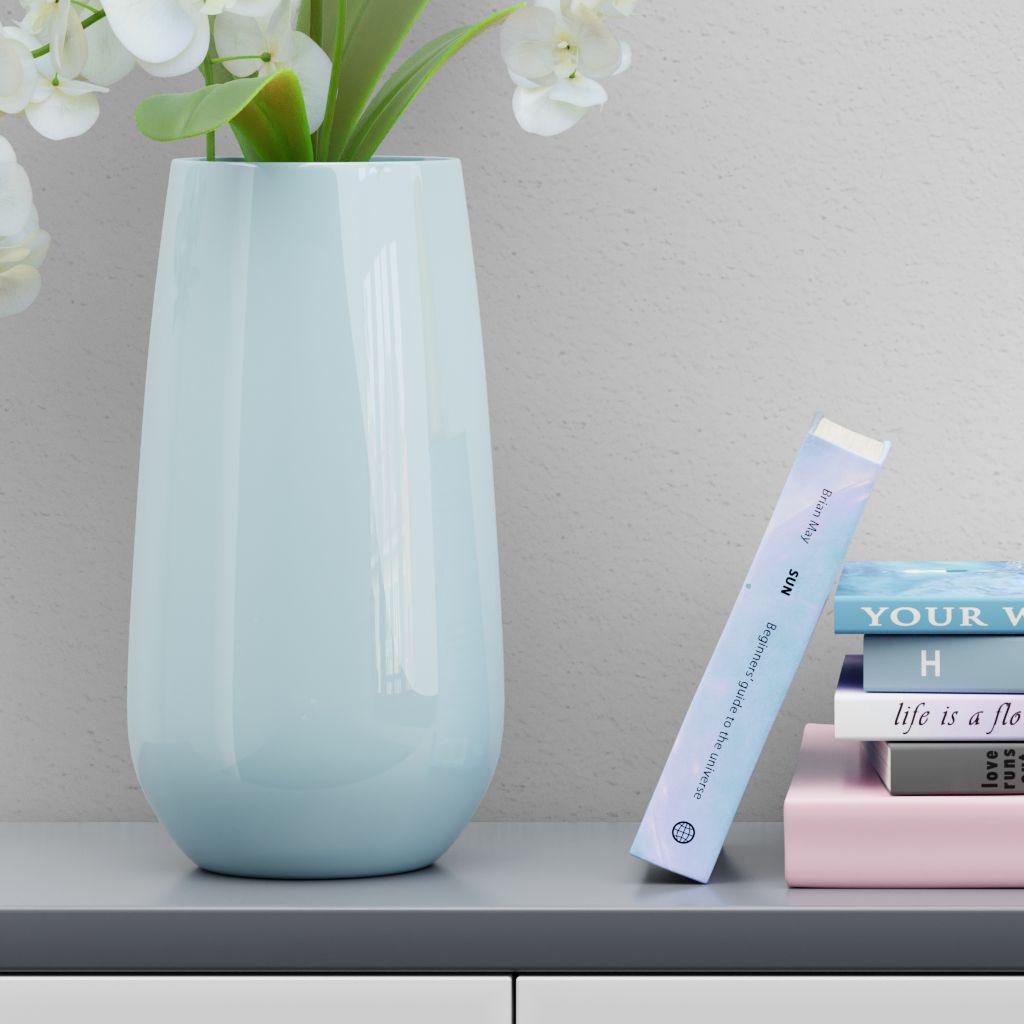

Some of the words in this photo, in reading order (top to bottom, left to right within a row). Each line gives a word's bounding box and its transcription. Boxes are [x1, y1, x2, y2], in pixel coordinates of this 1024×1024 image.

[812, 488, 833, 518] Brian
[800, 520, 820, 544] May
[780, 568, 799, 596] SUN
[861, 606, 989, 627] YOUR
[729, 681, 749, 714] guide
[723, 715, 735, 728] to
[894, 702, 930, 734] life
[940, 706, 958, 726] is
[968, 708, 984, 726] a
[714, 731, 729, 750] the
[693, 752, 719, 800] universe
[981, 750, 999, 788] love
[1003, 749, 1016, 789] runs
